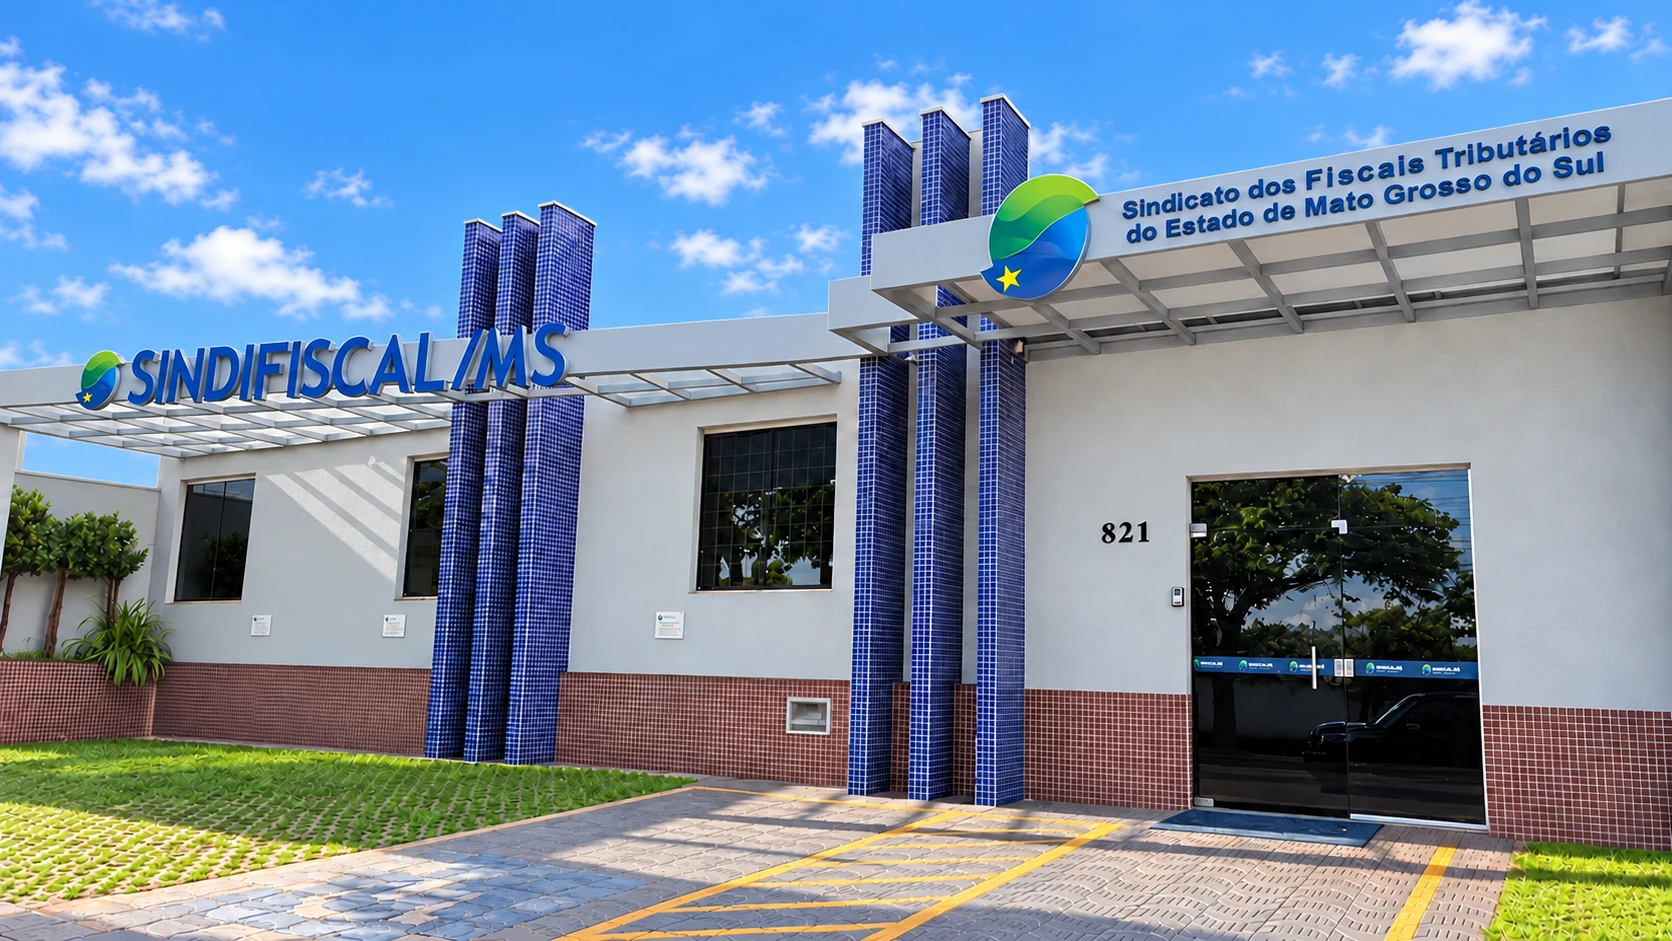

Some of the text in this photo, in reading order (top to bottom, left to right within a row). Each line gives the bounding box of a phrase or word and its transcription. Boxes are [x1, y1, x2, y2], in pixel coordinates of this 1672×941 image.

[1121, 125, 1612, 220] Sindicato dos Fiscais Tributários
[1126, 150, 1605, 244] do Estado de Mato Grosso do Sul
[127, 322, 569, 405] SINDIFISCAL/MS
[1101, 520, 1150, 544] 821
